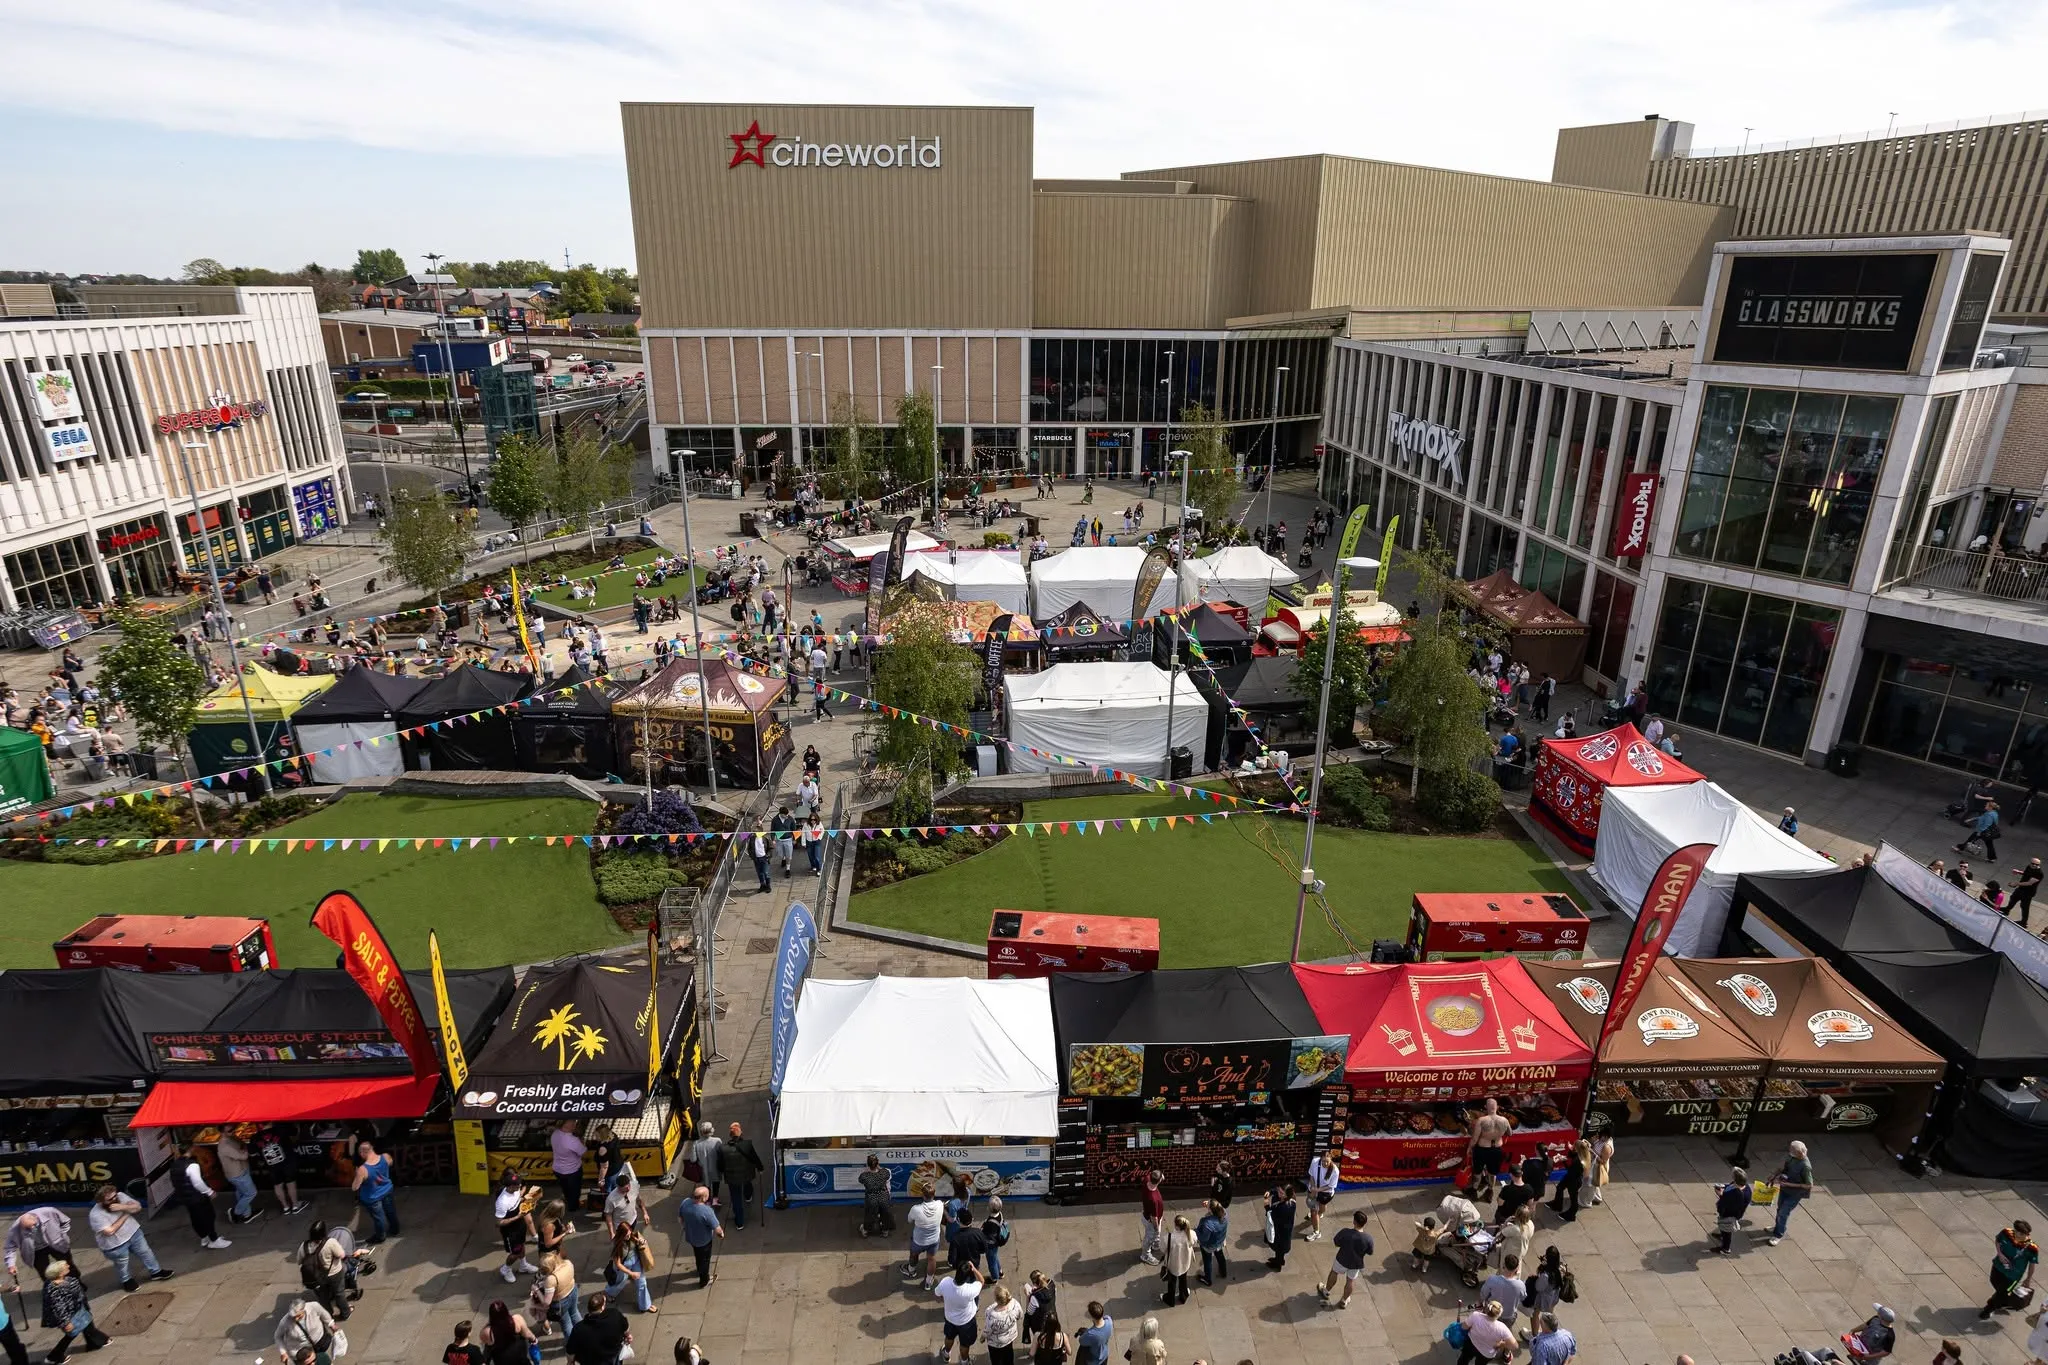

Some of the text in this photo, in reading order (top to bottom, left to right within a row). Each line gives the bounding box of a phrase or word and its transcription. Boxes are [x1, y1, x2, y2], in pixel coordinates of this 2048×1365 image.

[772, 136, 941, 168] cineworld
[1738, 300, 1902, 326] GLASSWORKS
[51, 427, 89, 448] SEGA
[987, 639, 1003, 667] COFFEE
[1654, 863, 1693, 914] MAN
[781, 935, 801, 1010] GYROS
[351, 931, 383, 971] SALT
[385, 978, 417, 1035] PEPPER
[1639, 1008, 1690, 1023] AUNT ANNIES
[1809, 1010, 1864, 1025] AUNT ANNIES
[152, 1032, 386, 1045] CHINESE BARBECUE STREET
[1182, 1055, 1250, 1067] SALT
[1385, 1065, 1558, 1083] Welcome to the WOK MAN
[1604, 1064, 1762, 1075] AUNT ANNIES TRADITIONAL CONFECTIONERY
[1776, 1066, 1939, 1077] AUNT ANNIES TRADITIONAL CONFECTIONERY
[503, 1083, 607, 1100] Freshly Baked
[1159, 1081, 1266, 1094] PEPPER
[495, 1099, 606, 1114] Coconut Cakes
[885, 1149, 970, 1159] GREEK GYROS
